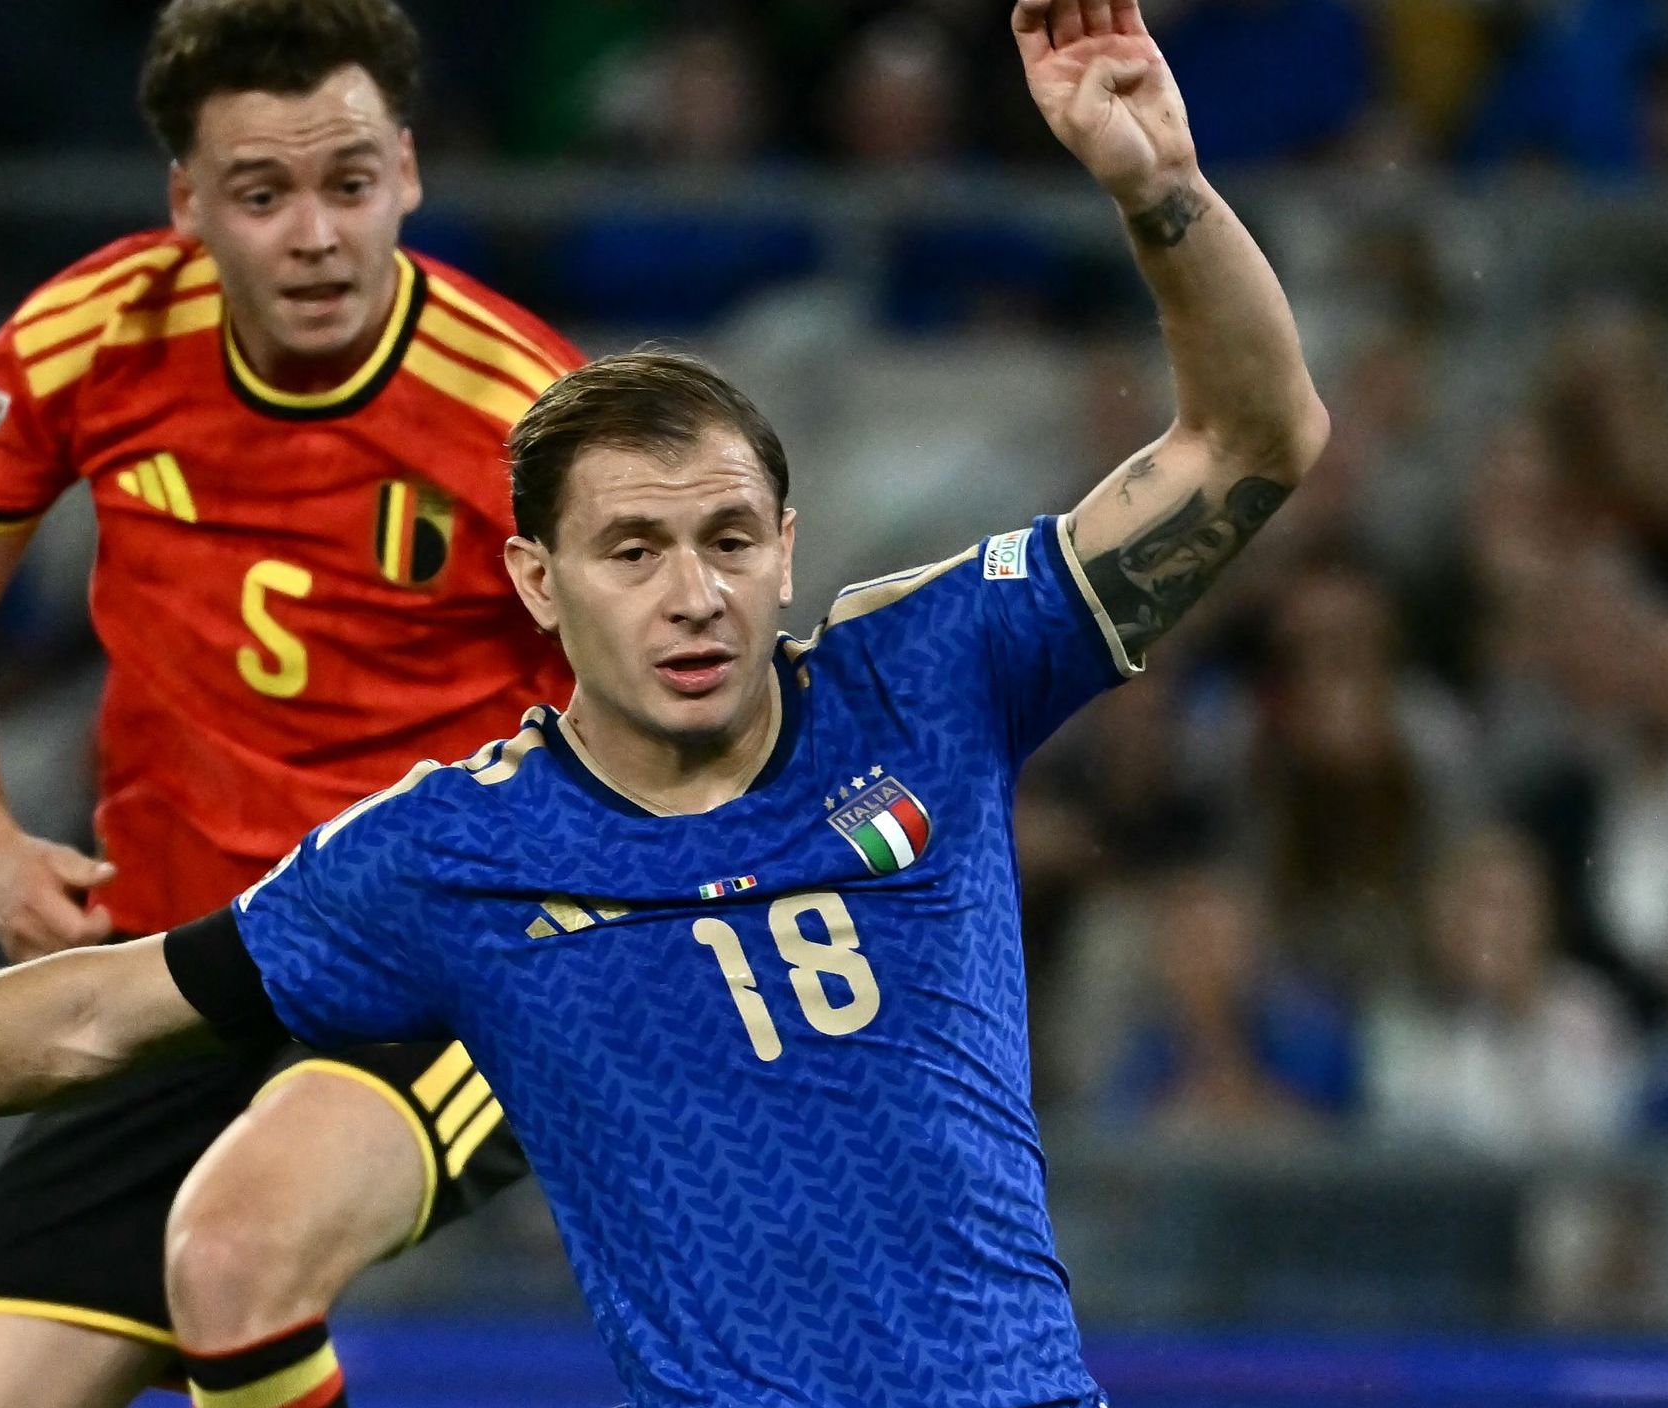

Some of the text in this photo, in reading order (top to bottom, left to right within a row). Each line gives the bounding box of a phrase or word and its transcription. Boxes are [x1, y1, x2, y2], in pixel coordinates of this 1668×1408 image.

[236, 559, 313, 699] 5
[835, 785, 899, 830] ITALIA
[692, 891, 881, 1062] 18
